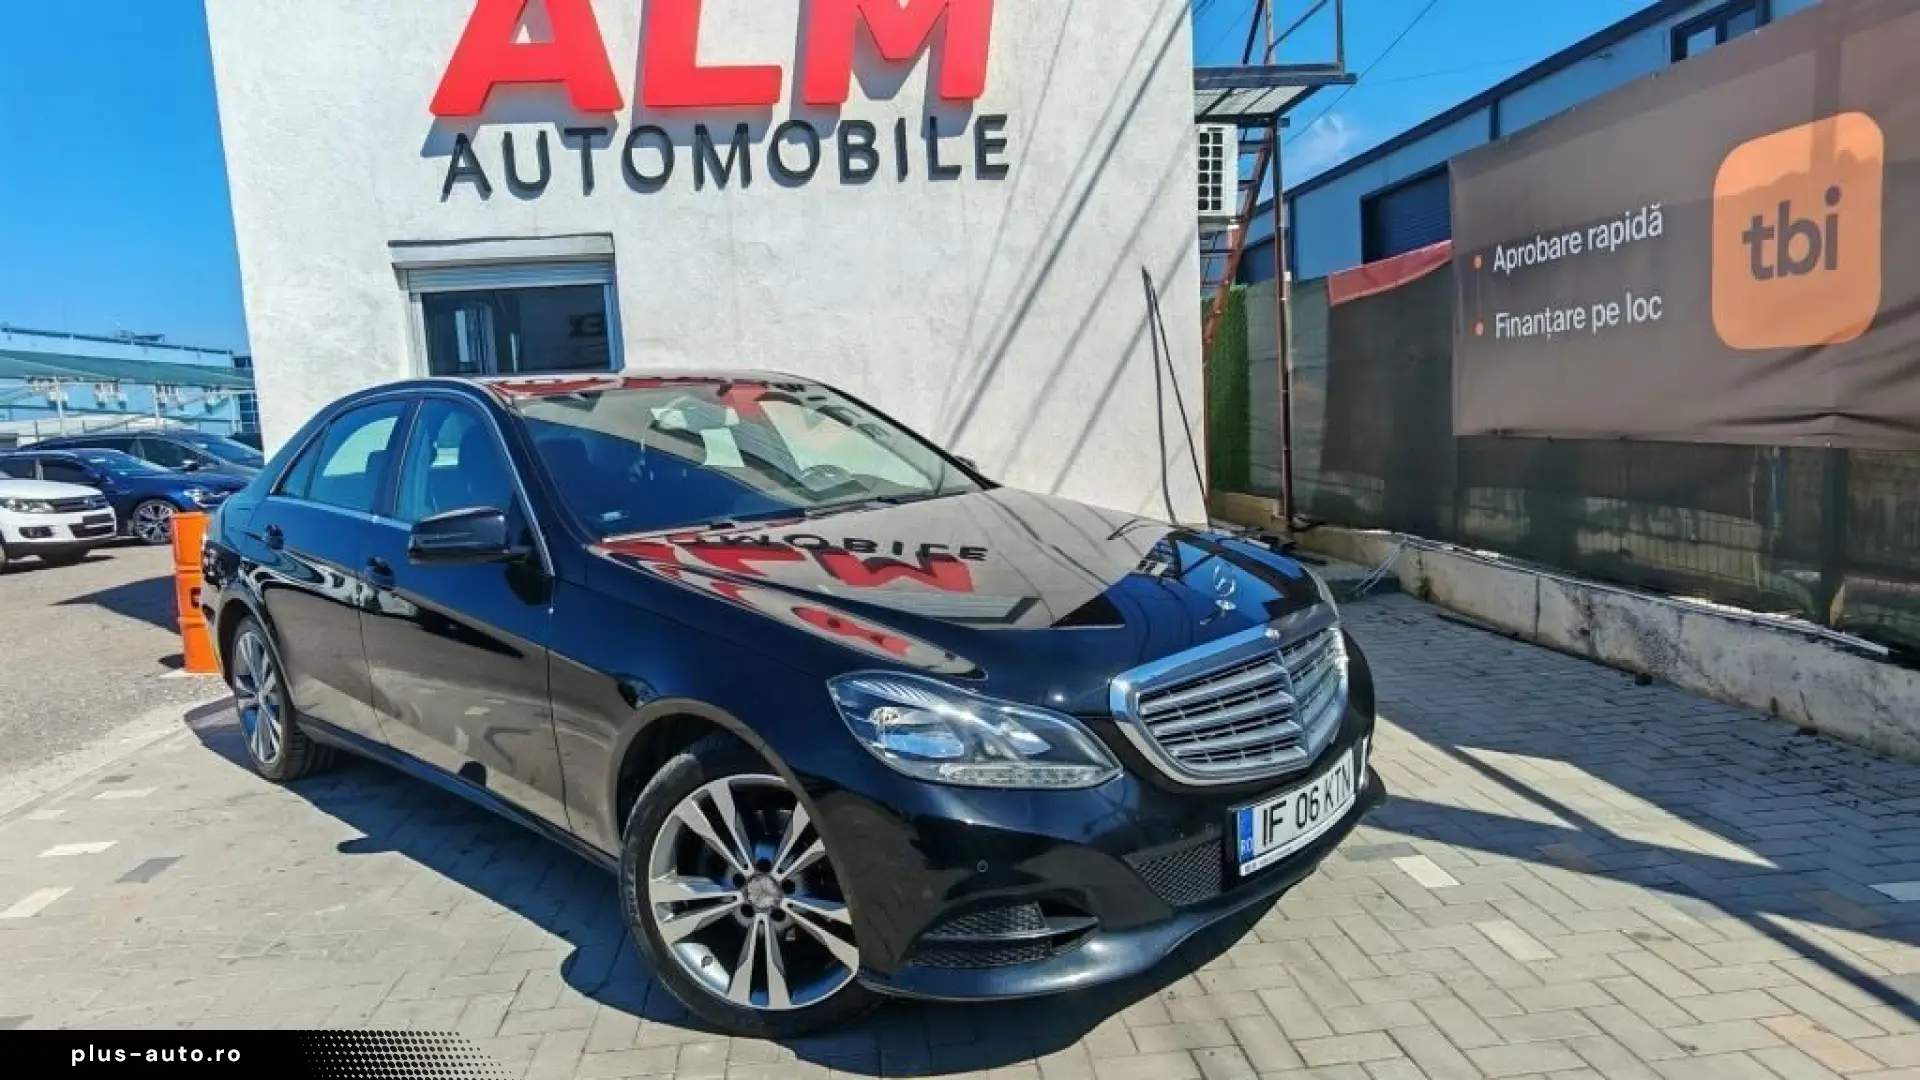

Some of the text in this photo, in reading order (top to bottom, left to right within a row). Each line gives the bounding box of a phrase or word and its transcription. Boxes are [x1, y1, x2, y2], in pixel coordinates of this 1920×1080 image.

[428, 0, 994, 116] ALM
[442, 115, 1010, 201] AUTOMOBILE
[1493, 203, 1664, 274] Aprobare rapidă
[1742, 186, 1841, 280] tbi
[1495, 292, 1663, 339] Finanțare pe loc
[1262, 762, 1351, 847] IF 06 KTN
